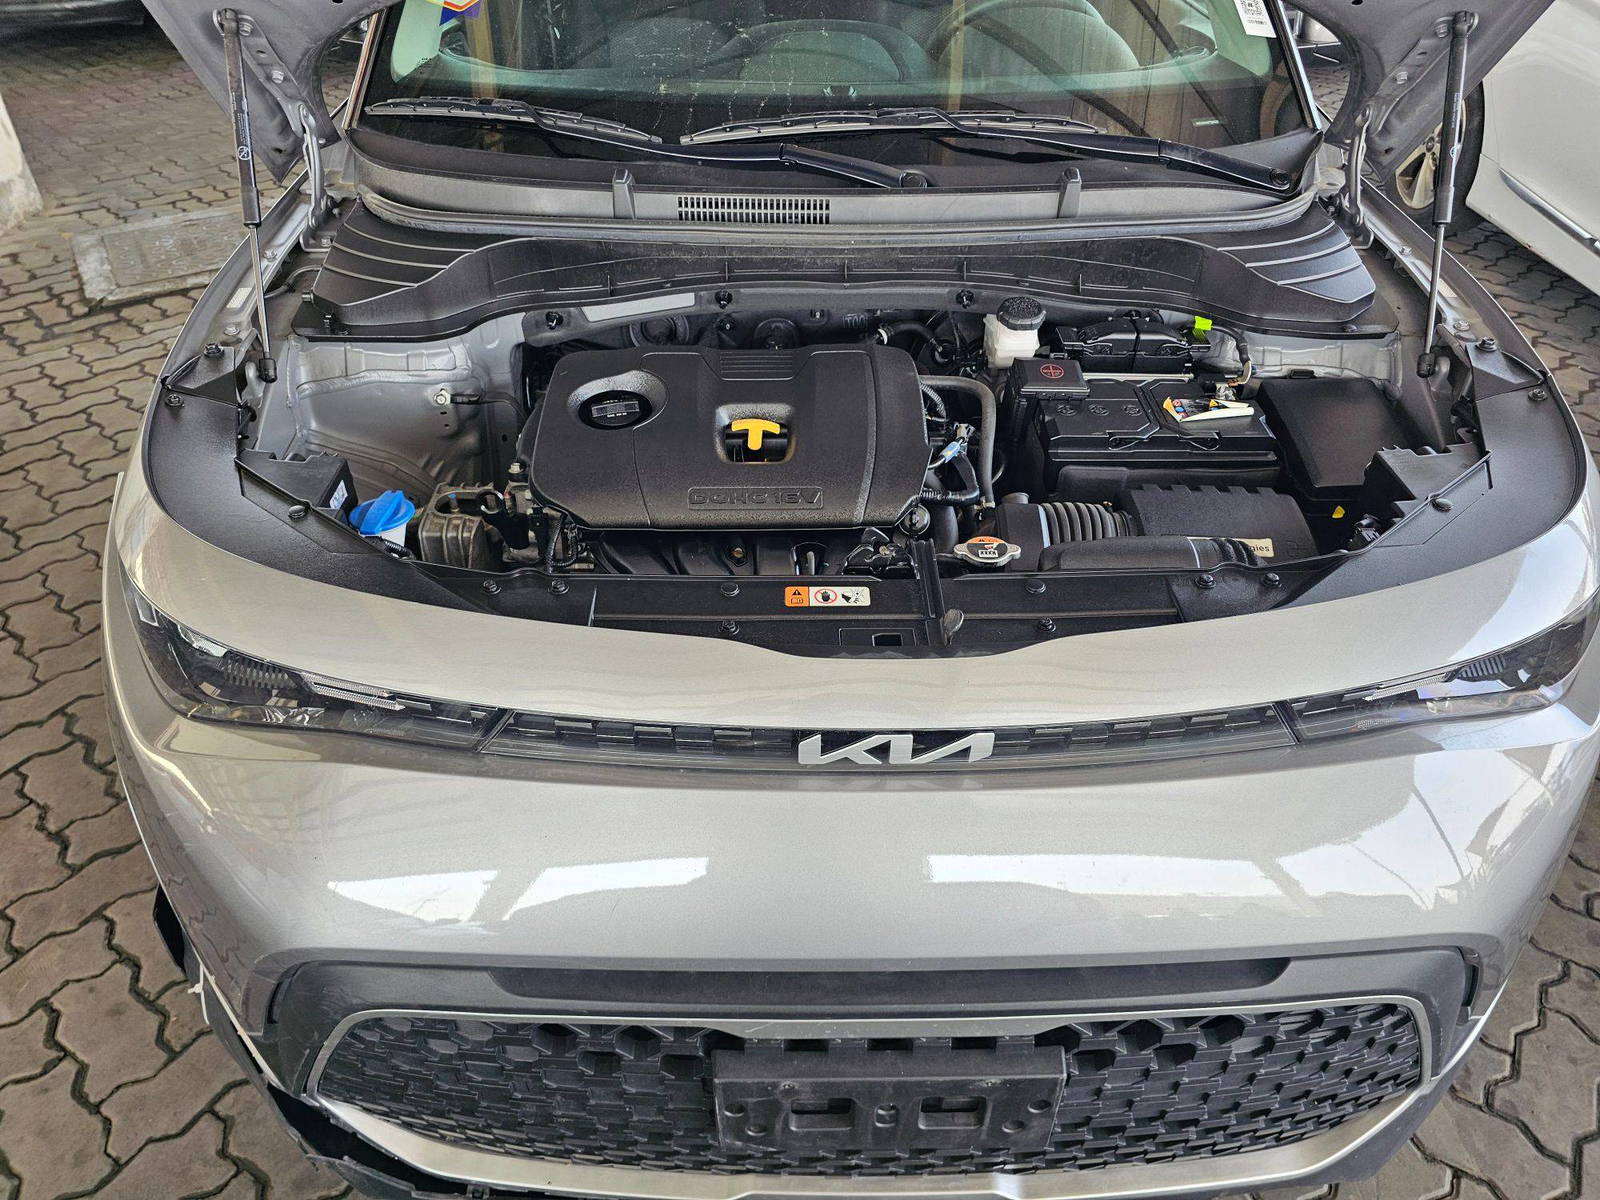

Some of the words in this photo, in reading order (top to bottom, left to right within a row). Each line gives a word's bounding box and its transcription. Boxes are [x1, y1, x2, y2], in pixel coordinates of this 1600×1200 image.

[690, 490, 768, 505] DOHC
[775, 489, 821, 505] 16V
[798, 732, 995, 764] KIA
